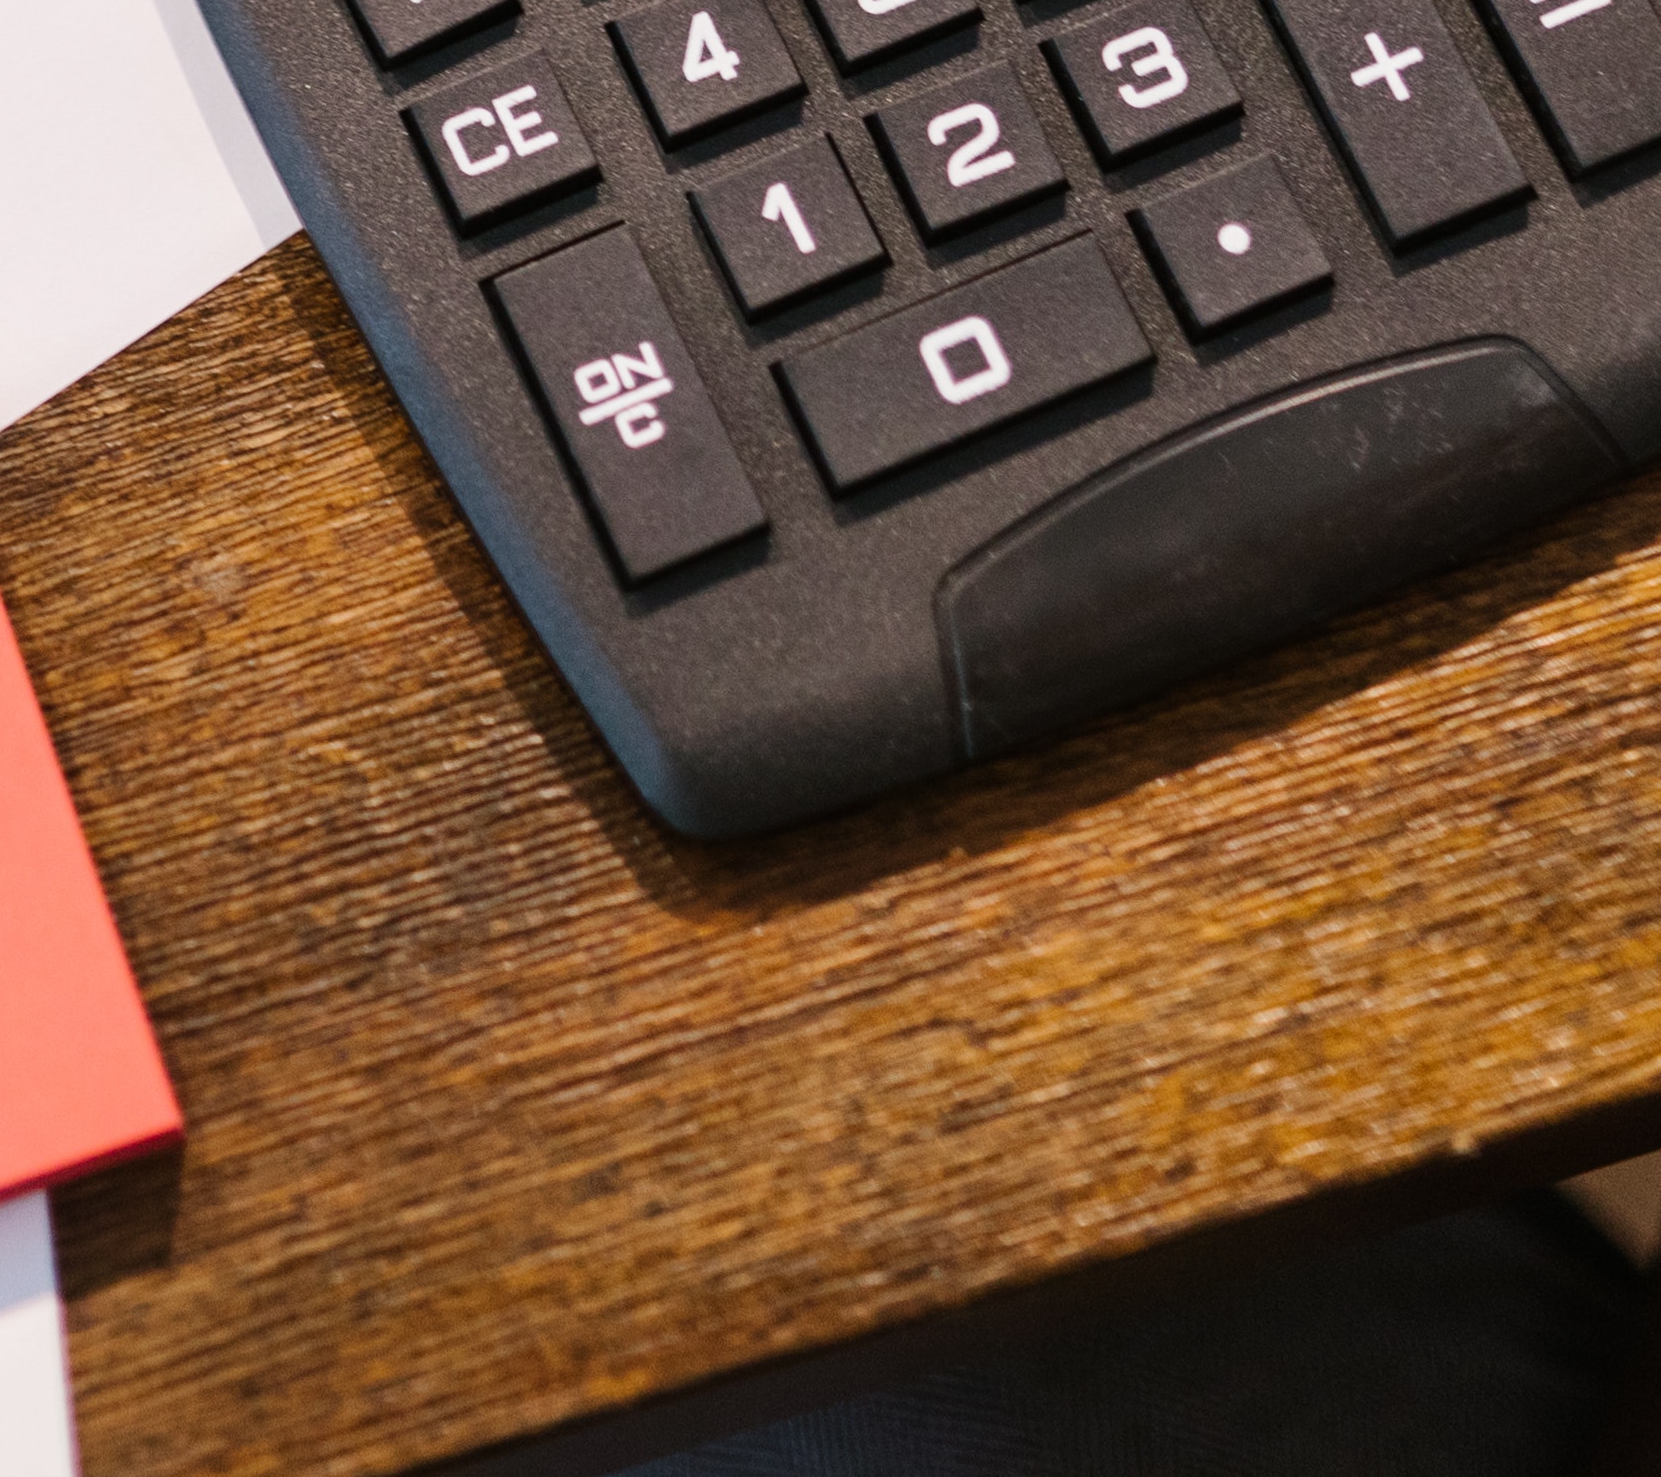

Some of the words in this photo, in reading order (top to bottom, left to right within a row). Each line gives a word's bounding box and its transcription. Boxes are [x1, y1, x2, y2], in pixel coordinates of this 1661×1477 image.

[683, 12, 739, 81] 4
[1103, 27, 1187, 107] 3
[1351, 33, 1423, 100] +
[443, 86, 558, 175] CE
[928, 104, 1014, 186] 2
[763, 183, 815, 253] 1
[920, 317, 1009, 403] 0
